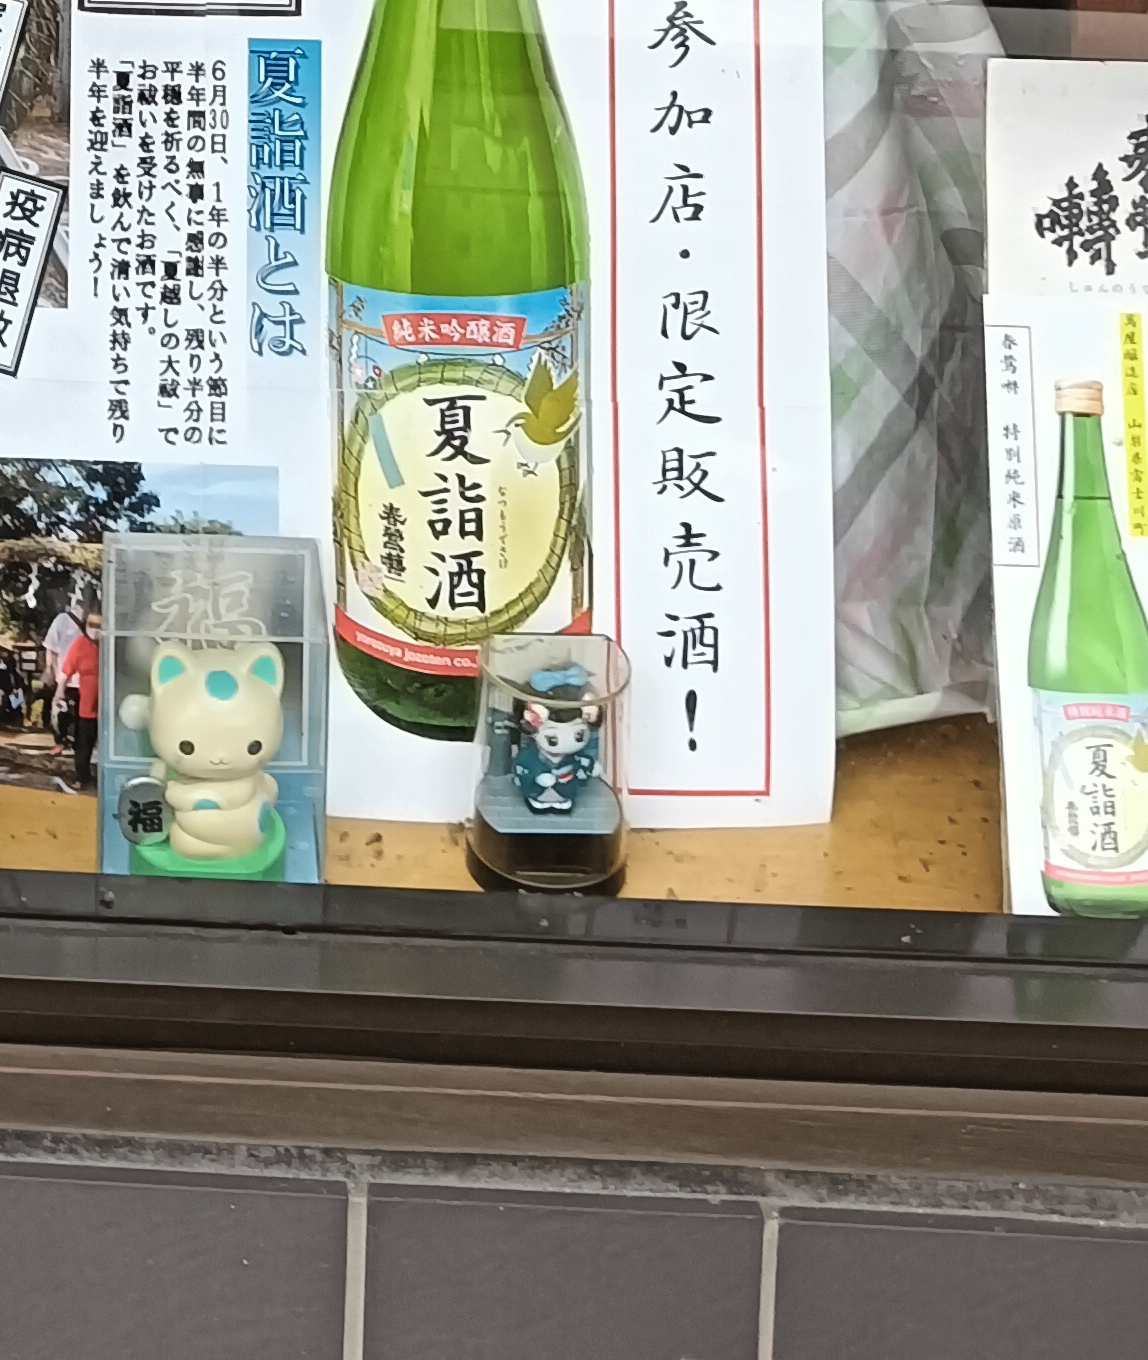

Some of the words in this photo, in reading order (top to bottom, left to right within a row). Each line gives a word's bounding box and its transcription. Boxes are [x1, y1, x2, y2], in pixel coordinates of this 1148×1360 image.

[248, 47, 311, 357] 夏詣酒とは
[391, 317, 517, 347] 純米吟醸酒
[417, 394, 493, 615] 夏詣酒
[128, 799, 165, 835] 福
[1078, 743, 1120, 854] 夏詣酒
